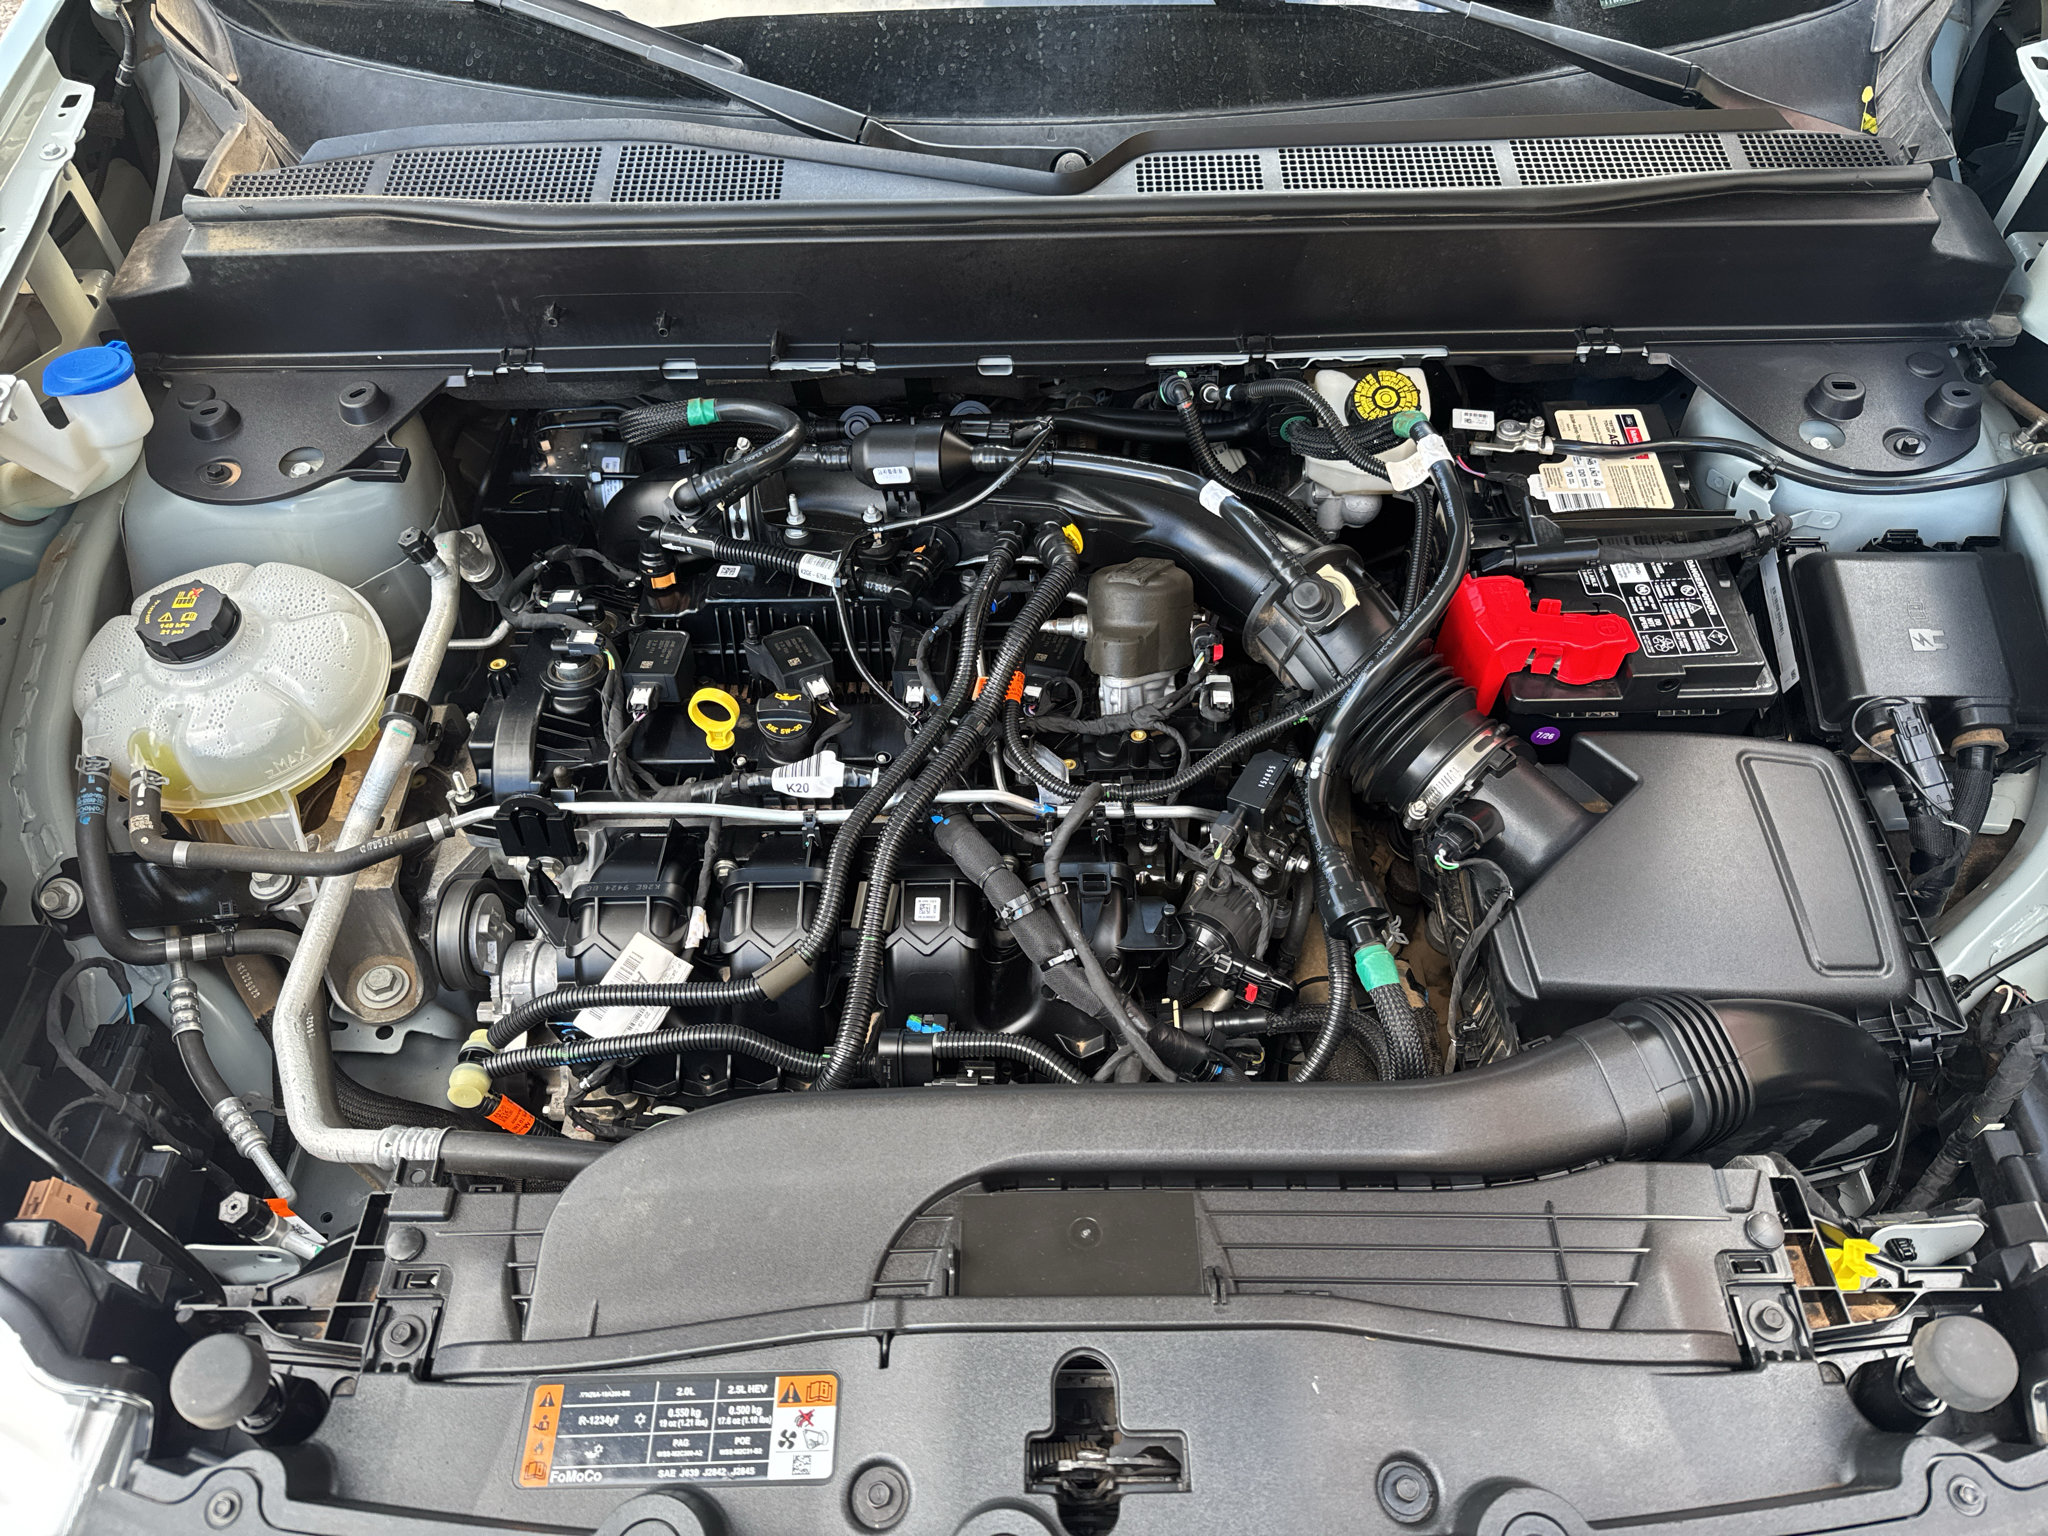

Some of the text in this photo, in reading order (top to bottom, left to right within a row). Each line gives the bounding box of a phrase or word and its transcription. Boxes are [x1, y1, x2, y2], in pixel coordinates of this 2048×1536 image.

[766, 724, 802, 734] SAE 5W-30
[1536, 732, 1555, 740] 7/26
[280, 746, 313, 770] MAX
[786, 783, 810, 793] K20
[676, 1387, 695, 1397] 2.0L
[728, 1384, 767, 1395] 2.5L HEV
[689, 1407, 702, 1418] kg
[750, 1404, 762, 1416] kg
[578, 1414, 620, 1427] R-1234yf
[734, 1436, 751, 1445] POE
[550, 1471, 602, 1483] FoMoCo
[658, 1469, 676, 1478] SAE
